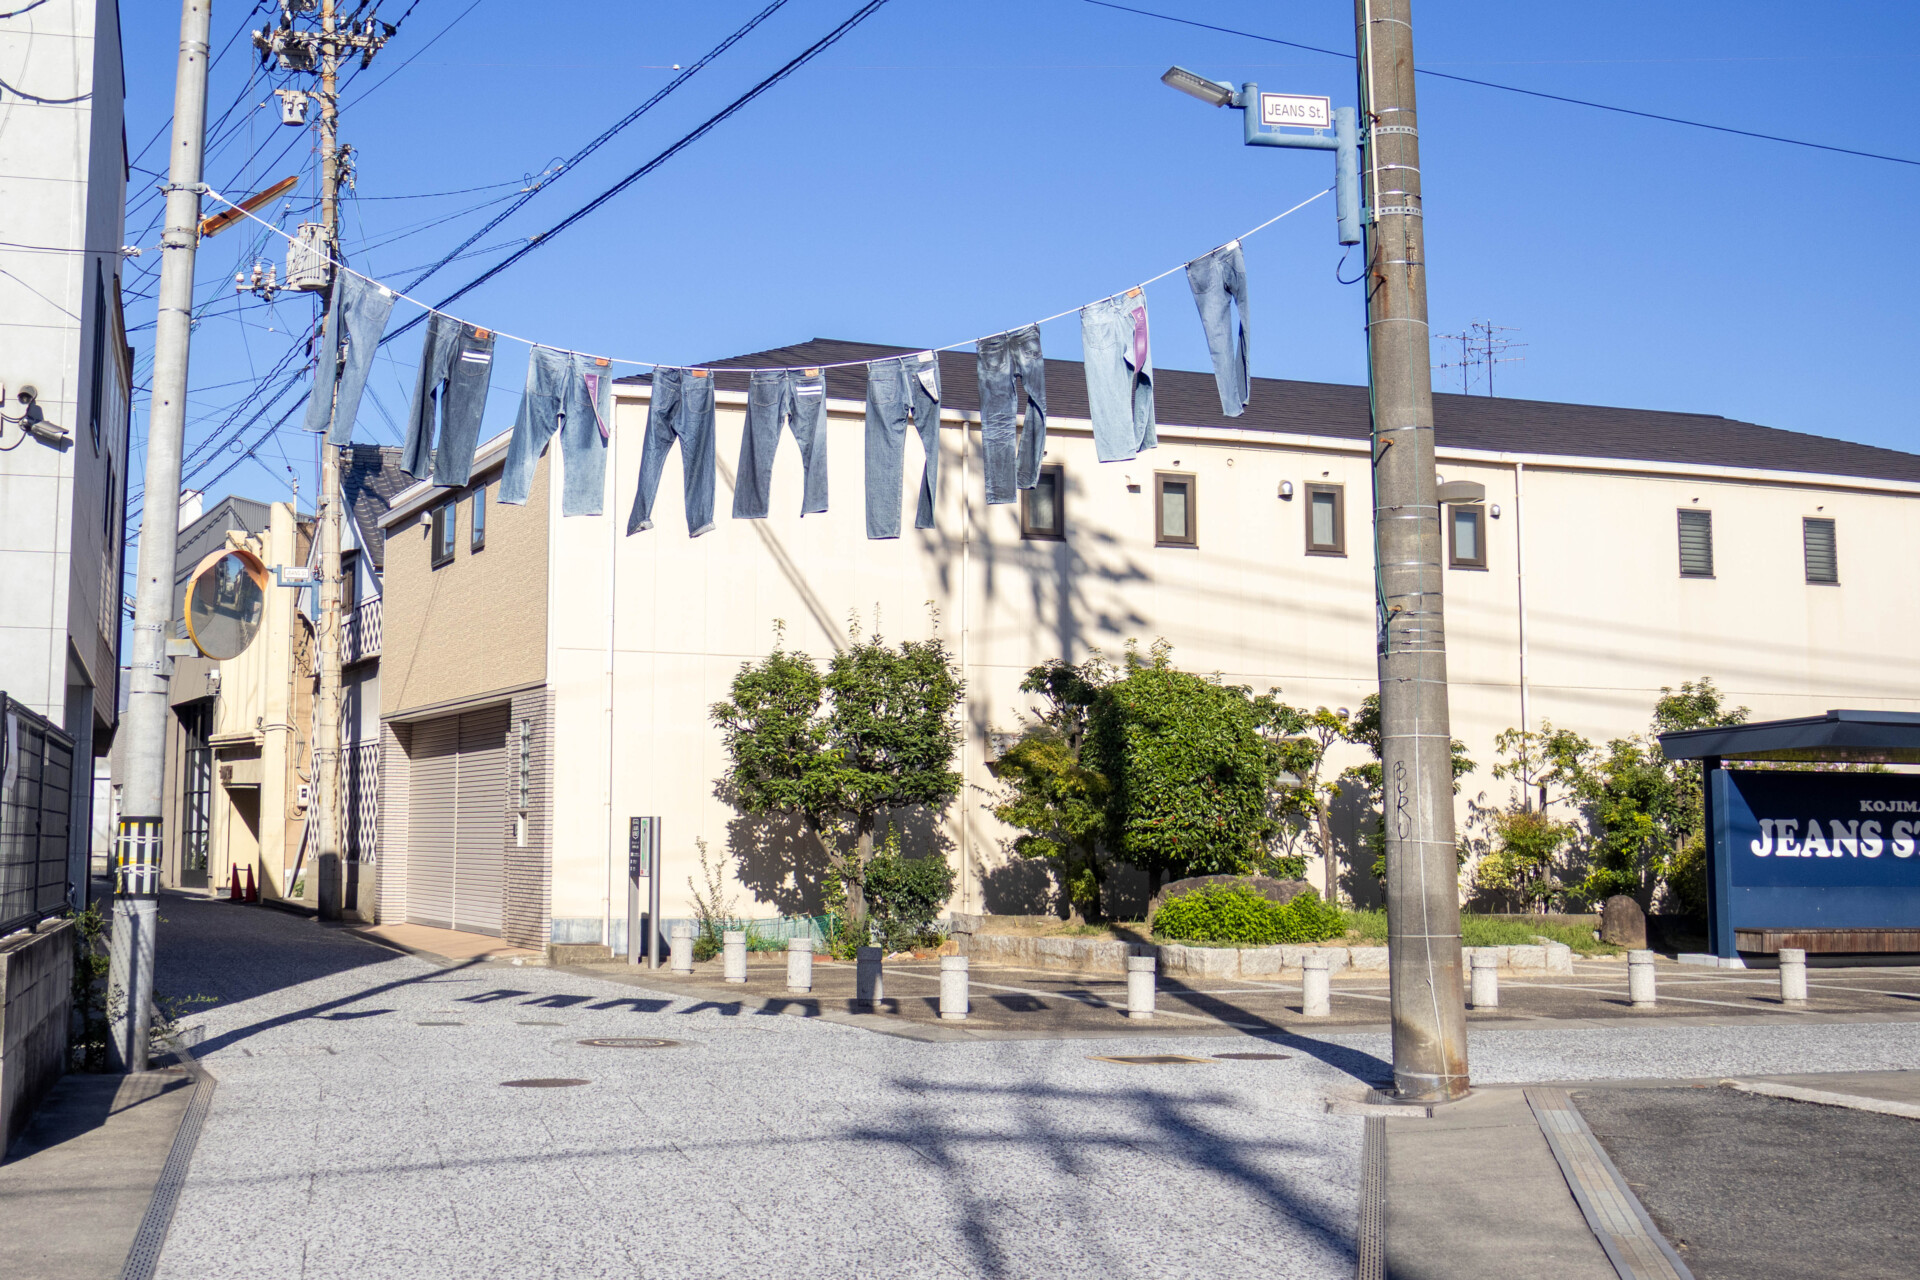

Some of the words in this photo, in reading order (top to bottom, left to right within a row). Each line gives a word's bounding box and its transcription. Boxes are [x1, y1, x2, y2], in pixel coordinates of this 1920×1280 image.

[1267, 103, 1306, 118] JEANS
[1308, 105, 1324, 119] St.
[1859, 800, 1920, 813] KOJIM
[1751, 818, 1883, 858] JEANS
[1892, 819, 1920, 859] S
